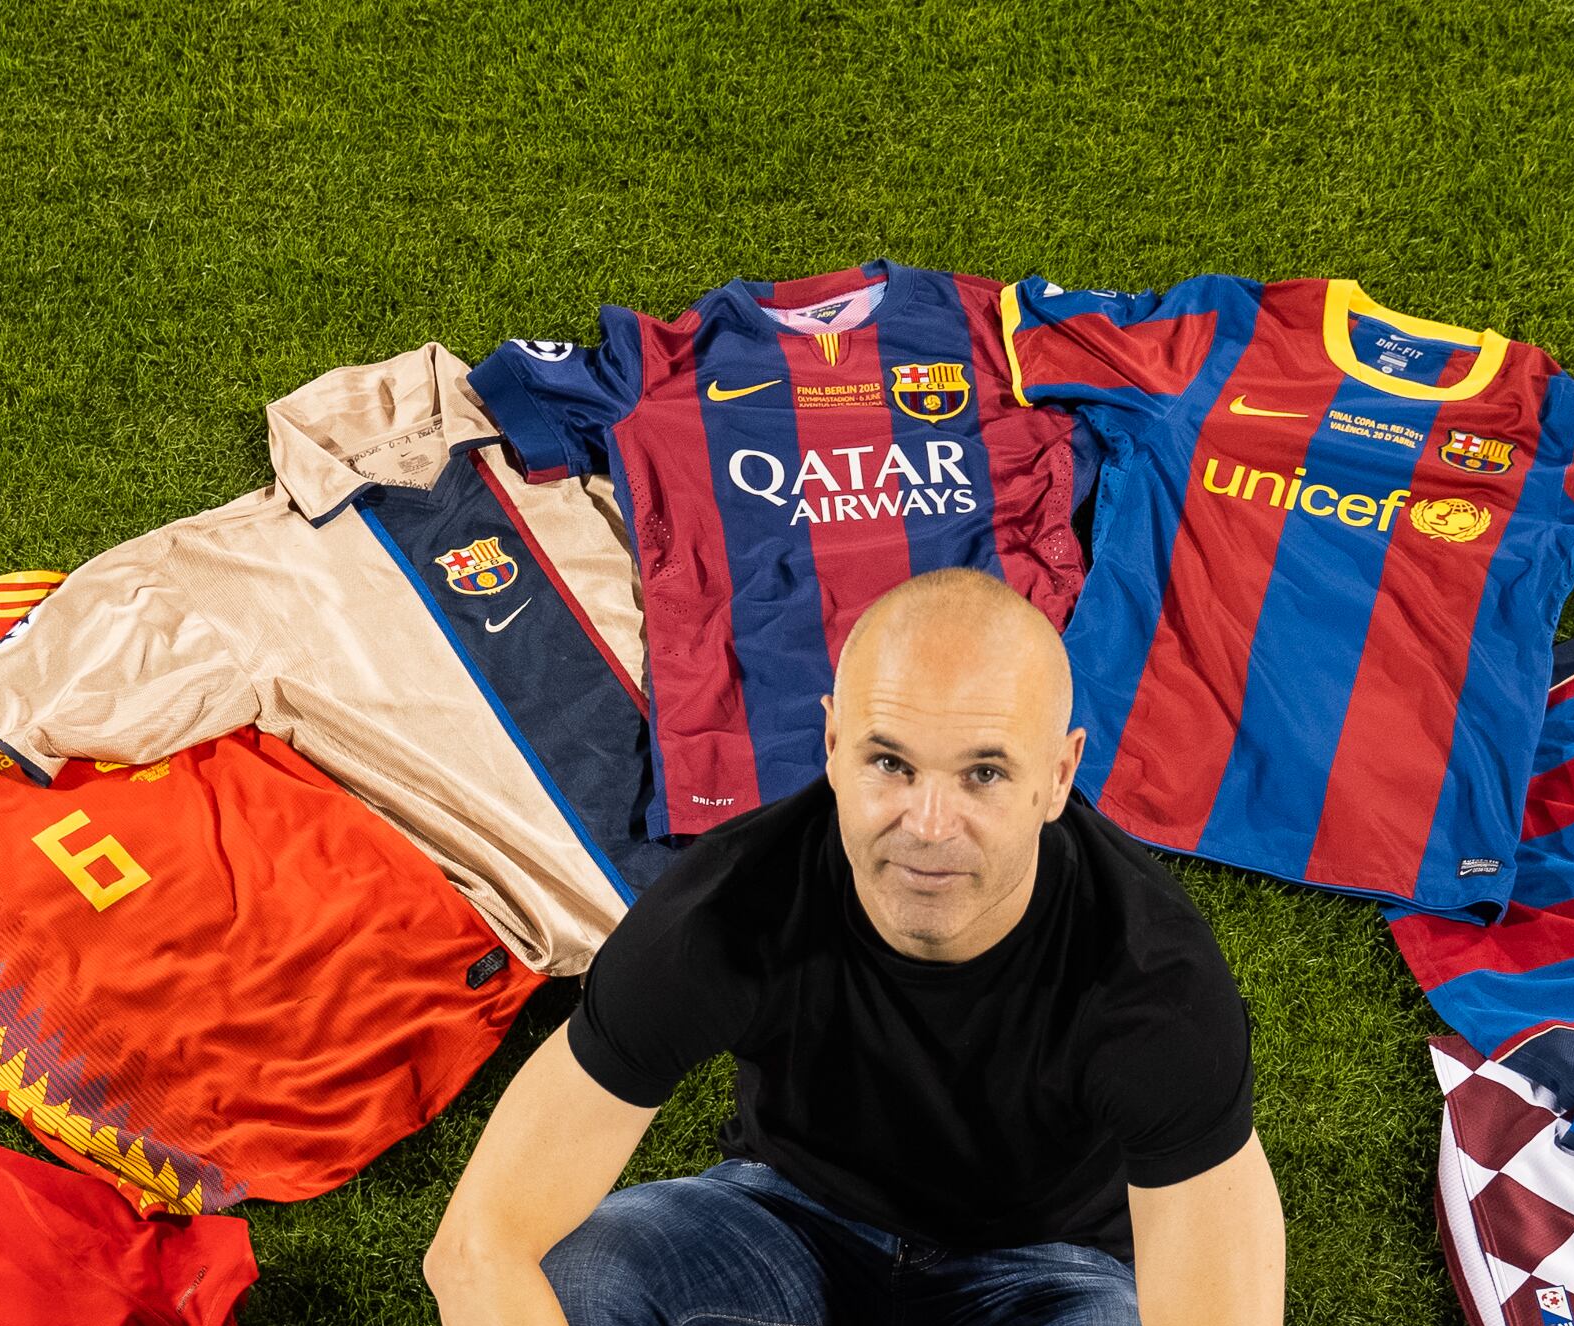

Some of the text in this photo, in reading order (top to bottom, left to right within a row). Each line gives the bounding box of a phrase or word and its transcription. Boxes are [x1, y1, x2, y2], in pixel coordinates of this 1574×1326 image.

[1375, 338, 1424, 359] DRI-FIT
[797, 382, 881, 396] FINAL BERLIN 2015
[797, 395, 855, 403] OLYMPIASTADION
[859, 394, 865, 402] 6
[865, 392, 882, 401] JUNE
[1328, 410, 1353, 424] FINAL
[1353, 416, 1376, 429] COPA
[1390, 424, 1404, 434] REI
[1404, 428, 1424, 442] 2011
[1372, 431, 1384, 440] 20
[728, 440, 972, 507] QATAR
[790, 488, 977, 526] AIRWAYS
[1204, 458, 1410, 530] unicef
[692, 795, 735, 806] DRI-FIT
[31, 809, 152, 913] 6
